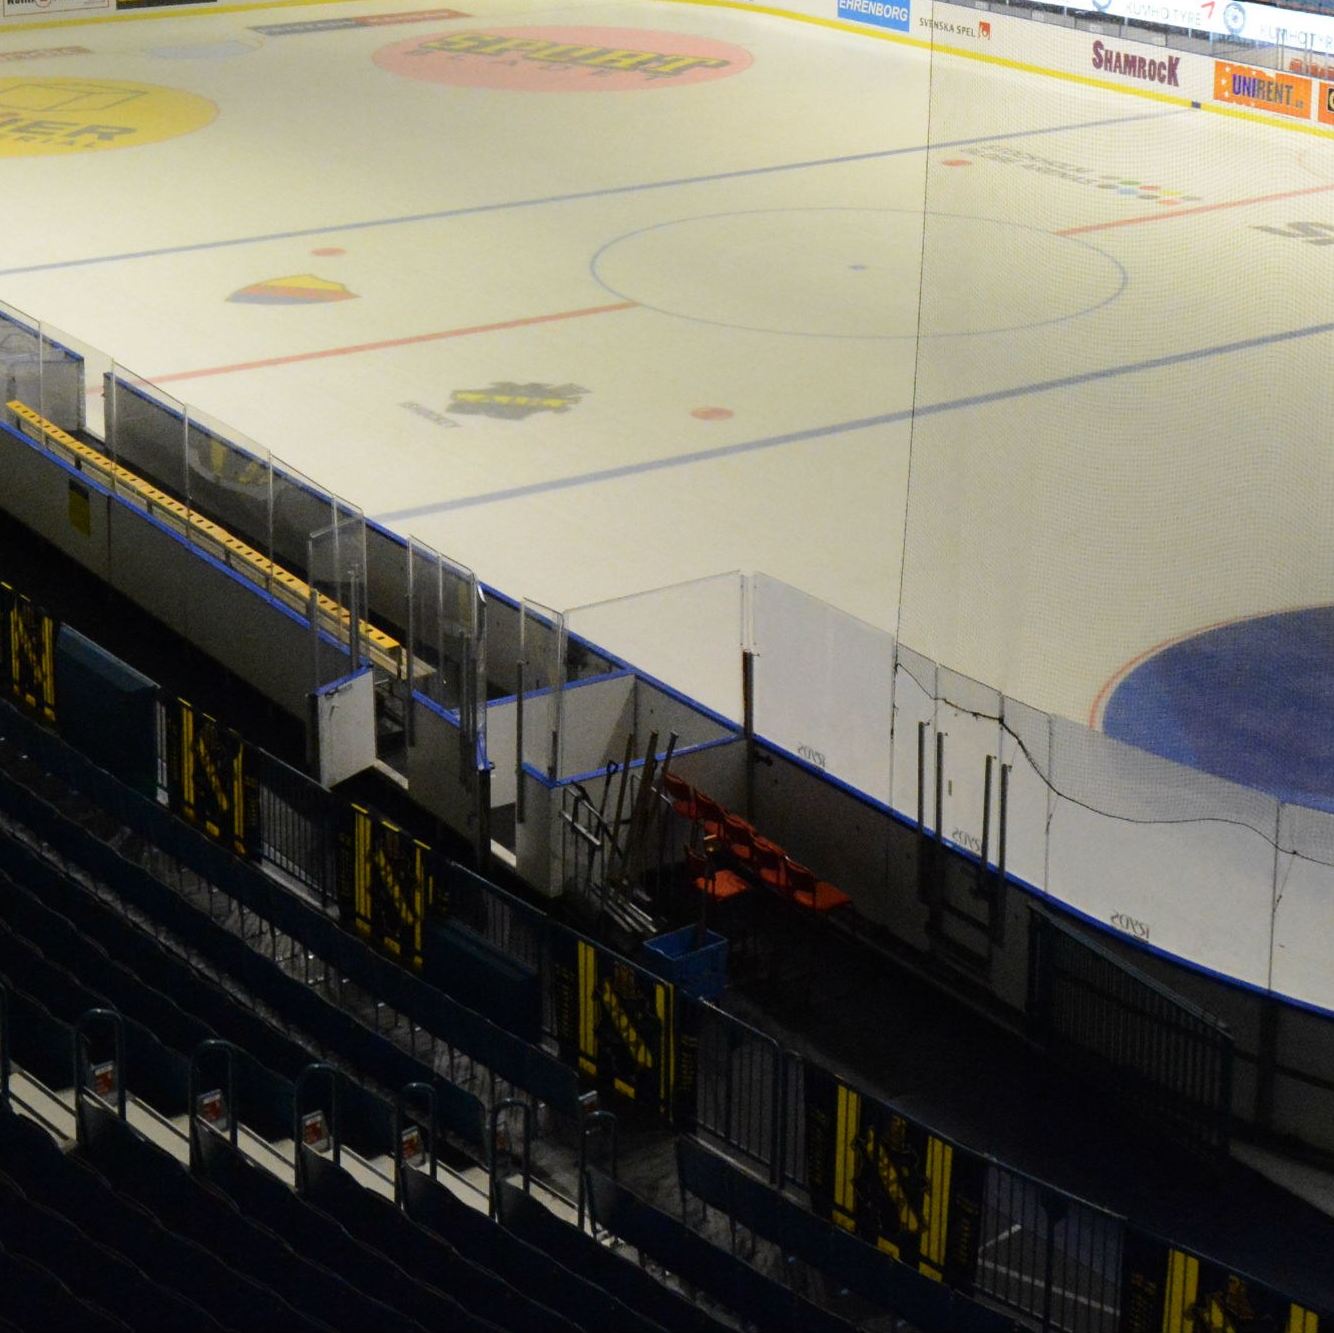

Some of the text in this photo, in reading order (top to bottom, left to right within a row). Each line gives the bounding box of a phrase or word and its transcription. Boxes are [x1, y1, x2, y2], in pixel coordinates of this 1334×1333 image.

[1125, 1, 1201, 26] KUMHO TYRE
[919, 17, 976, 38] SVENSKA SPEL
[1092, 40, 1181, 88] SHAMROCK
